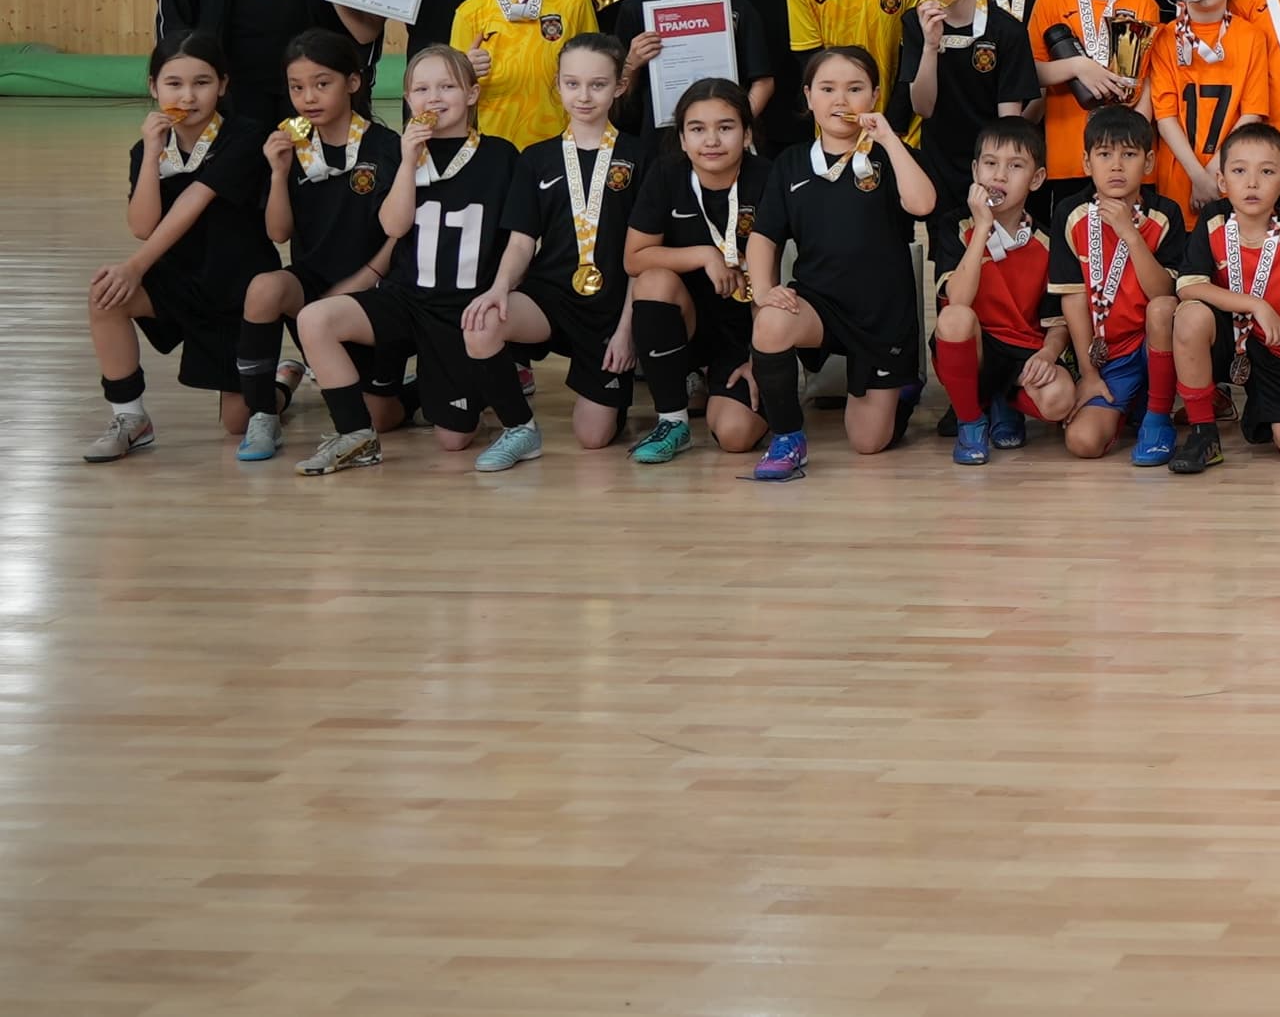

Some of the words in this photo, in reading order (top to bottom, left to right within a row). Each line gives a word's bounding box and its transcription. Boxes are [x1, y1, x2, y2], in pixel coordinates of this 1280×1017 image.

[658, 18, 710, 32] ГРАМОТА
[1182, 83, 1232, 154] 17
[586, 151, 610, 220] QAZAQSTAN
[414, 200, 485, 289] 11
[1089, 210, 1102, 282] QAZAQSTAN
